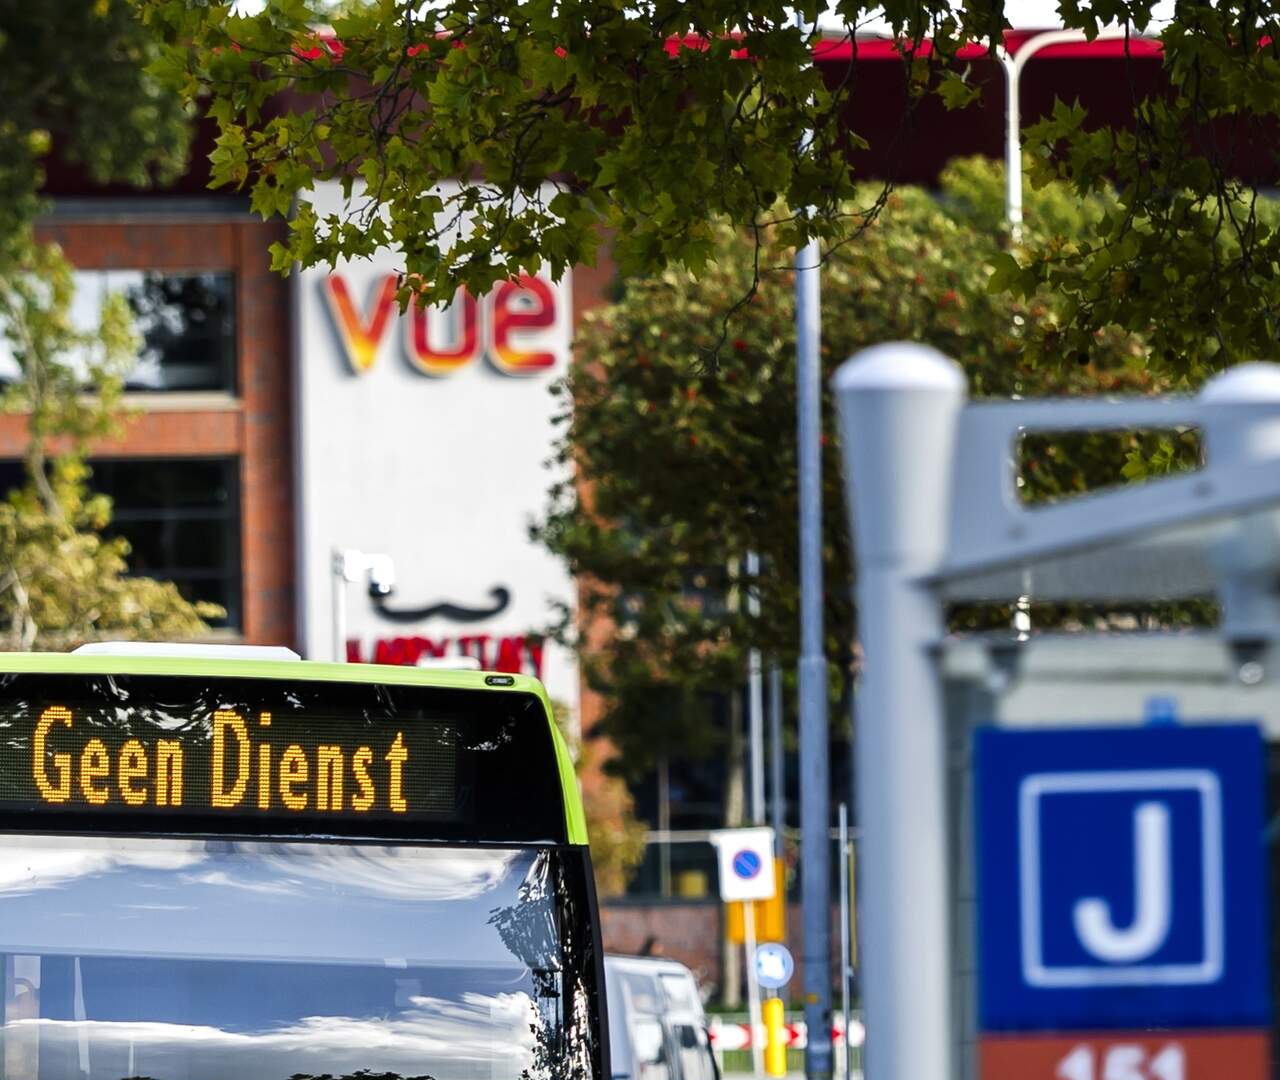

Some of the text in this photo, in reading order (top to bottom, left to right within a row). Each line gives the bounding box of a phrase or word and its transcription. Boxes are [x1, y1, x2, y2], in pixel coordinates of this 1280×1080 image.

[32, 705, 184, 807] Geen
[212, 710, 409, 813] Dienst
[1073, 801, 1172, 963] J
